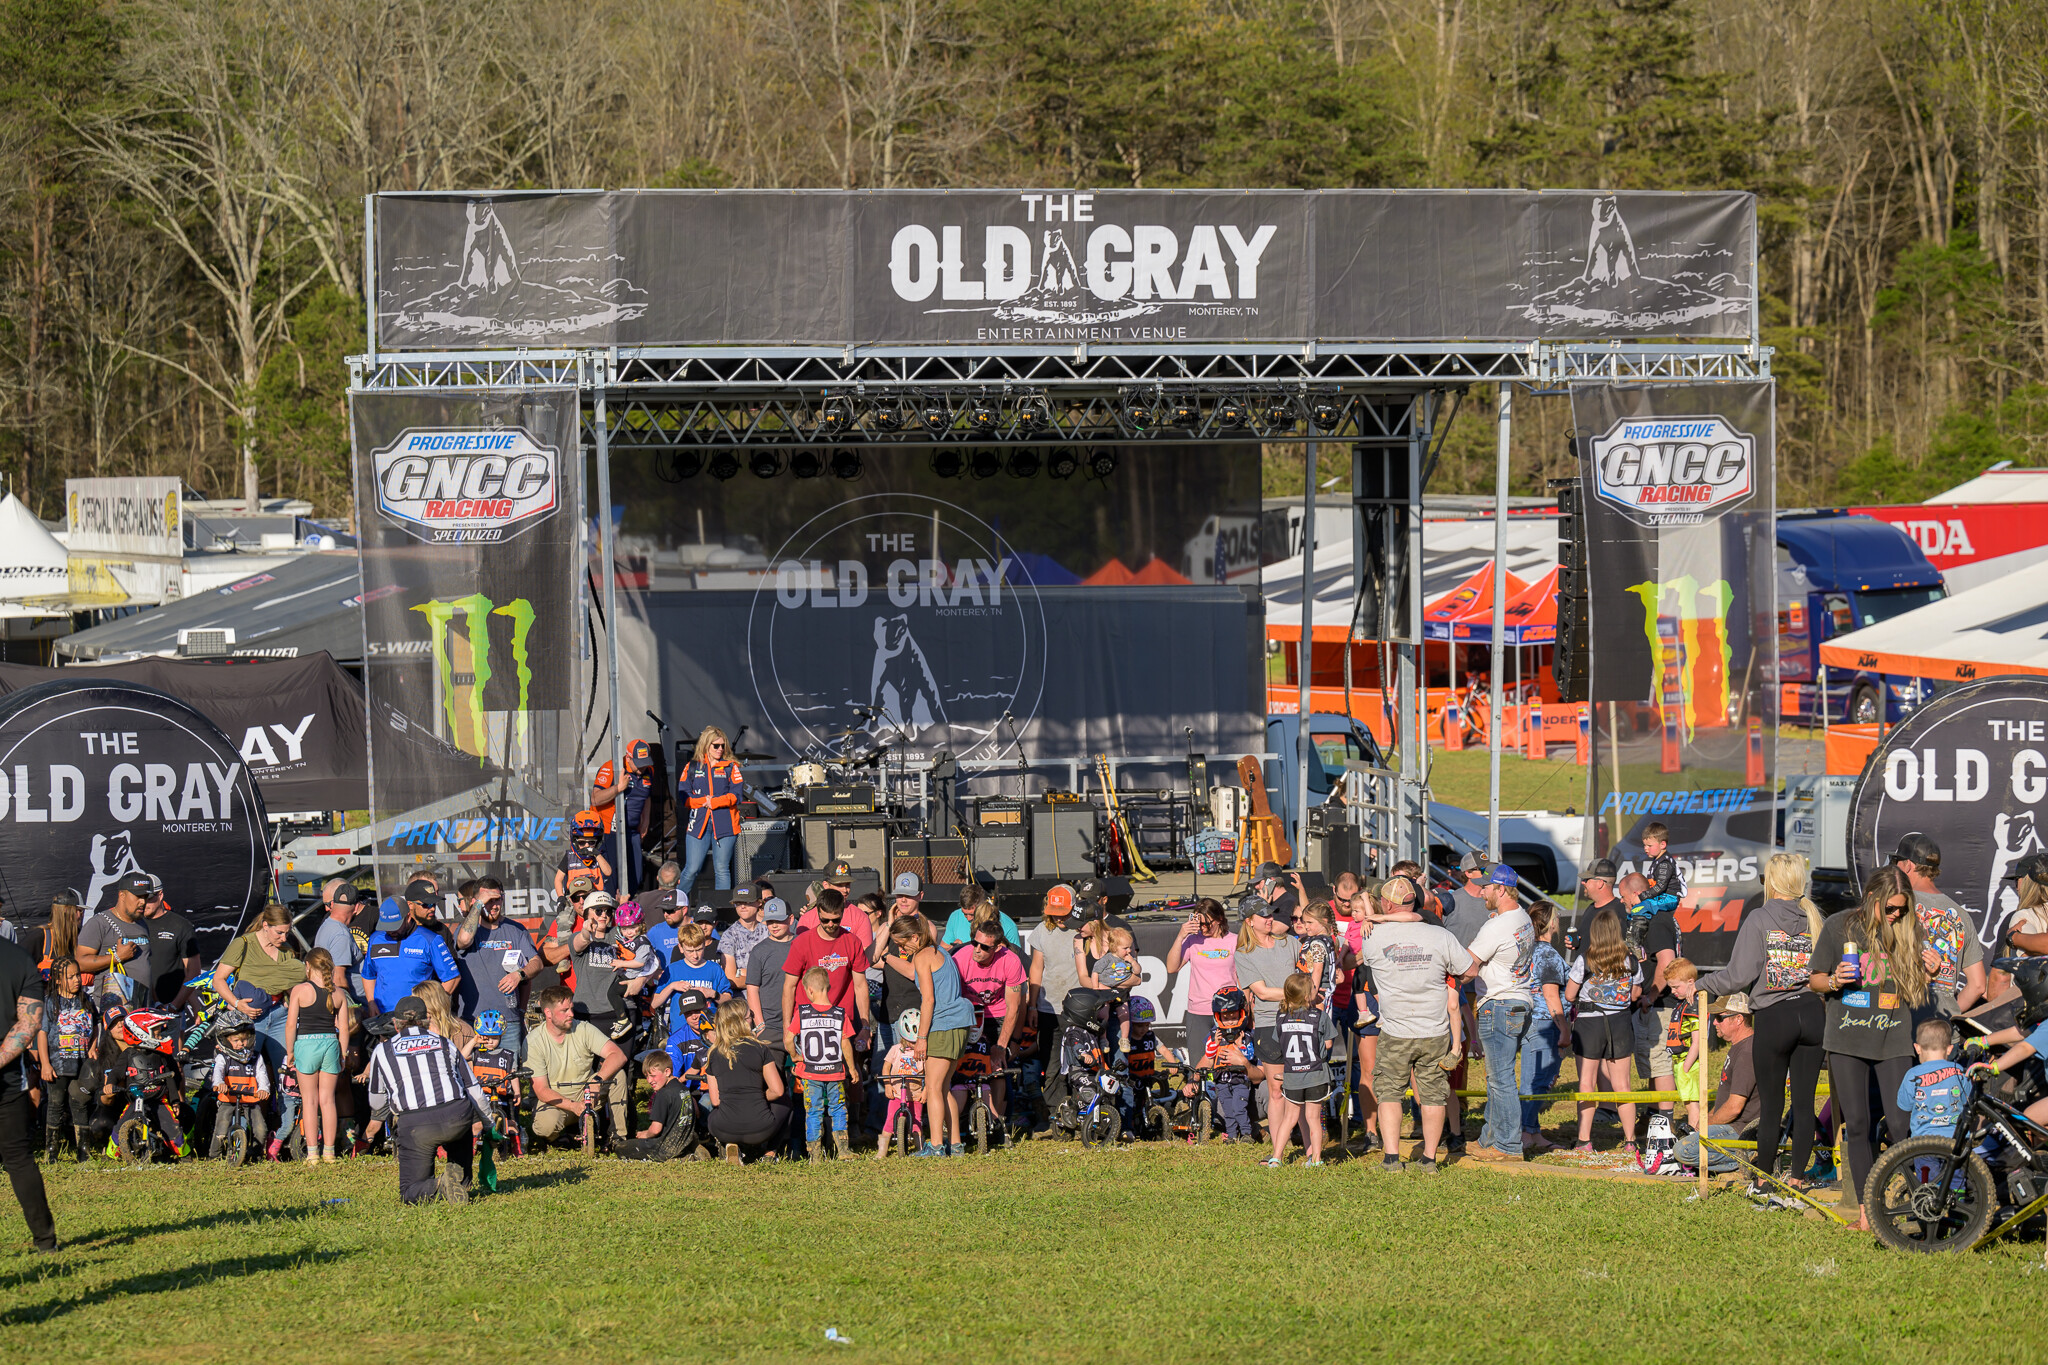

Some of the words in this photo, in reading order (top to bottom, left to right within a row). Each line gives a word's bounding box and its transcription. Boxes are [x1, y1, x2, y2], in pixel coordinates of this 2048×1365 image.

[1021, 194, 1094, 221] THE
[888, 224, 1031, 302] OLD
[1084, 224, 1277, 301] GRAY
[1060, 300, 1077, 308] 1893
[1189, 307, 1243, 317] MONTEREY,
[1246, 307, 1259, 316] TN
[977, 327, 1122, 340] ENTERTAINMENT
[1130, 326, 1187, 339] VENUE
[1623, 423, 1716, 439] PROGRESSIVE
[407, 435, 516, 450] PROGRESSIVE
[1603, 441, 1744, 486] GNCC
[384, 453, 548, 501] GNCC
[1637, 484, 1714, 504] RACING
[423, 499, 514, 518] RACING
[1646, 513, 1704, 525] SPECIALIZED
[432, 529, 502, 541] SPECIALIZED
[866, 533, 915, 552] THE
[1890, 519, 1975, 556] NDA
[775, 559, 868, 609] OLD
[887, 558, 1012, 608] GRAY
[935, 608, 988, 617] MONTEREY,
[990, 608, 1003, 616] TN
[232, 647, 298, 658] PECIALIZED
[368, 641, 433, 655] S-WOR
[1858, 653, 1878, 668] KTM
[1956, 663, 1976, 679] KTM
[1988, 720, 2045, 741] THE
[80, 732, 139, 755] THE
[239, 713, 315, 766] AY
[251, 765, 293, 774] ONTEREY,
[1883, 748, 1989, 802] OLD
[107, 762, 241, 823] GRAY
[1598, 788, 1758, 815] PROGRESSIVE
[163, 822, 218, 833] MONTEREY,
[220, 822, 233, 832] TN
[387, 816, 565, 847] PROGRESSIVE
[1393, 954, 1432, 963] PRESERVE
[396, 1039, 440, 1052] GNCC
[804, 1030, 840, 1062] 05
[977, 1042, 987, 1053] 79
[1144, 1040, 1154, 1051] 30
[1286, 1035, 1316, 1063] 41
[958, 1058, 986, 1073] KTM
[1919, 1072, 1938, 1087] HOT
